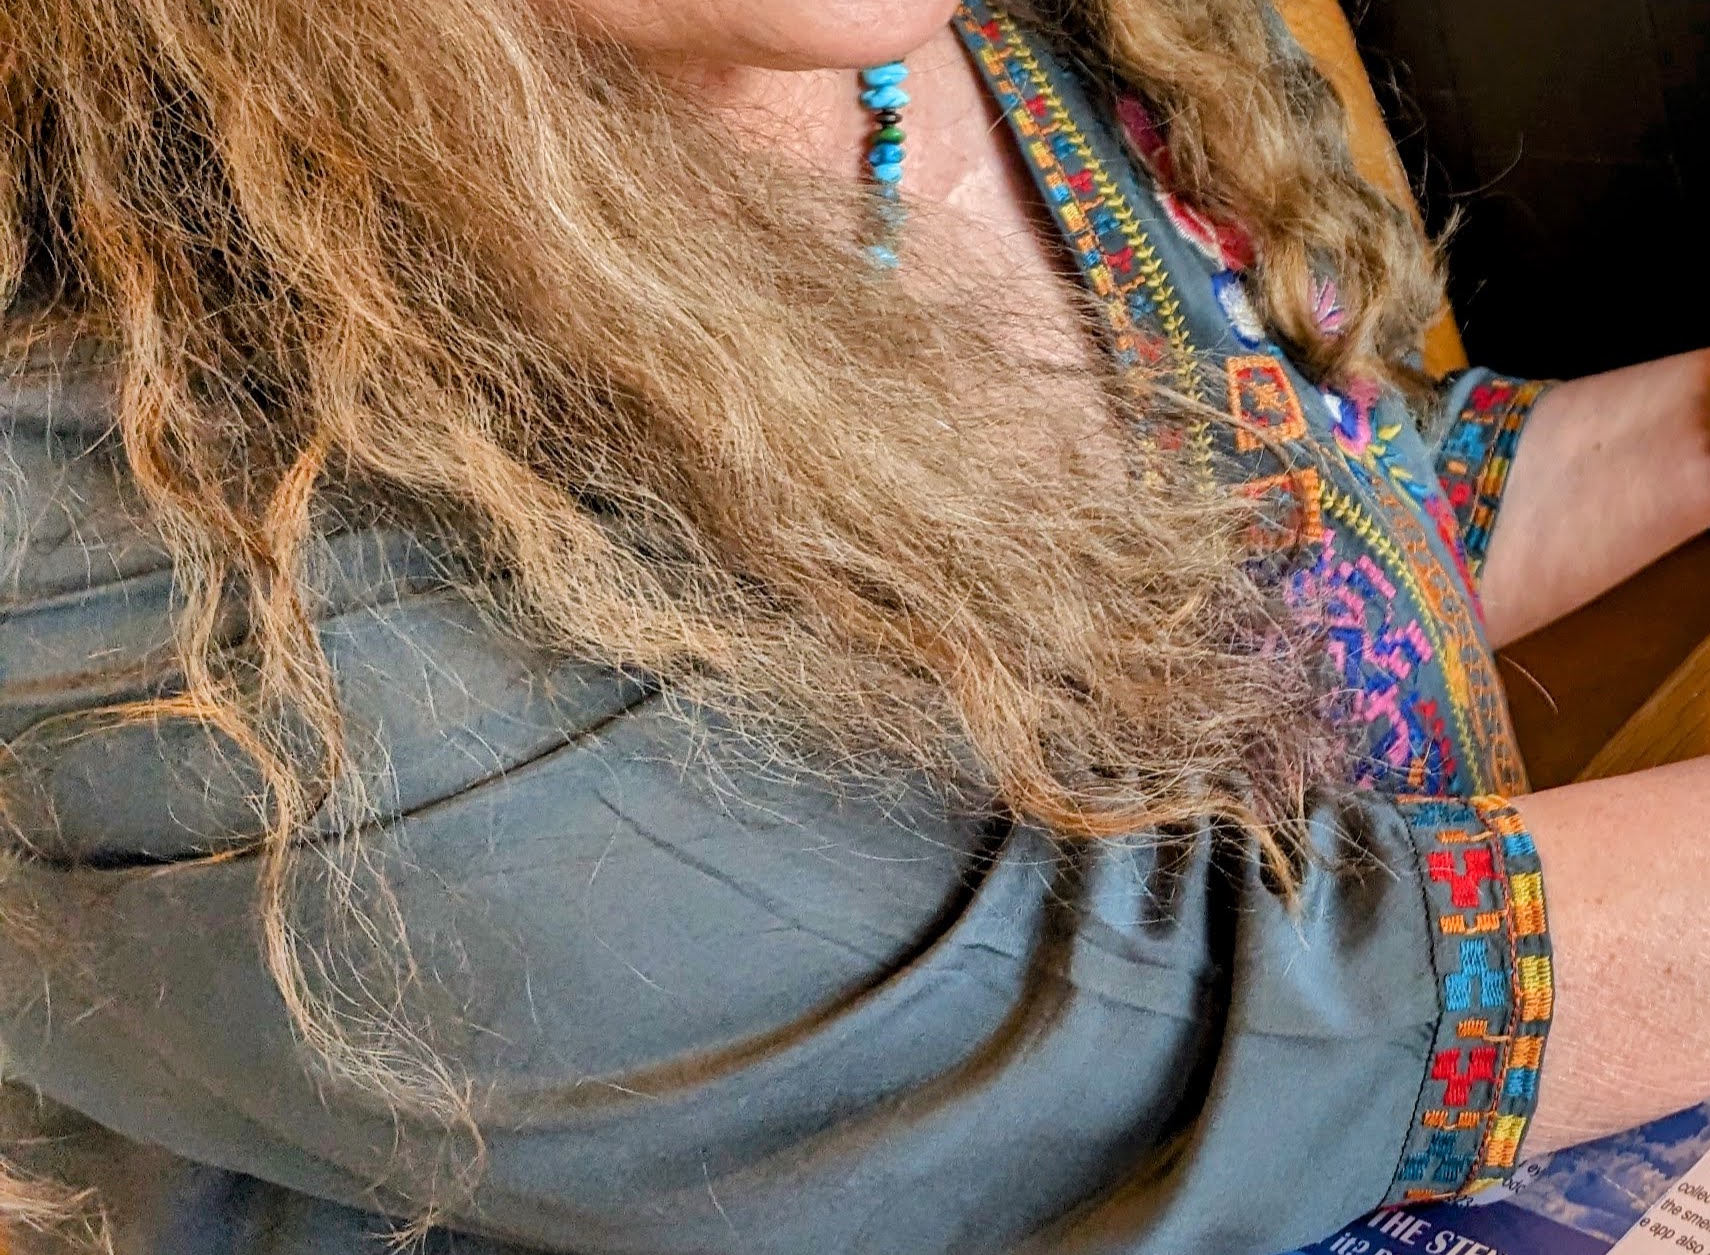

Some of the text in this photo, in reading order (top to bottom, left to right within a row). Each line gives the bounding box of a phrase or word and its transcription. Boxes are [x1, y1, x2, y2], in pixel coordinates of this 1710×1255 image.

[1660, 1197, 1682, 1216] the
[1649, 1219, 1676, 1241] app
[1675, 1233, 1706, 1255] also
